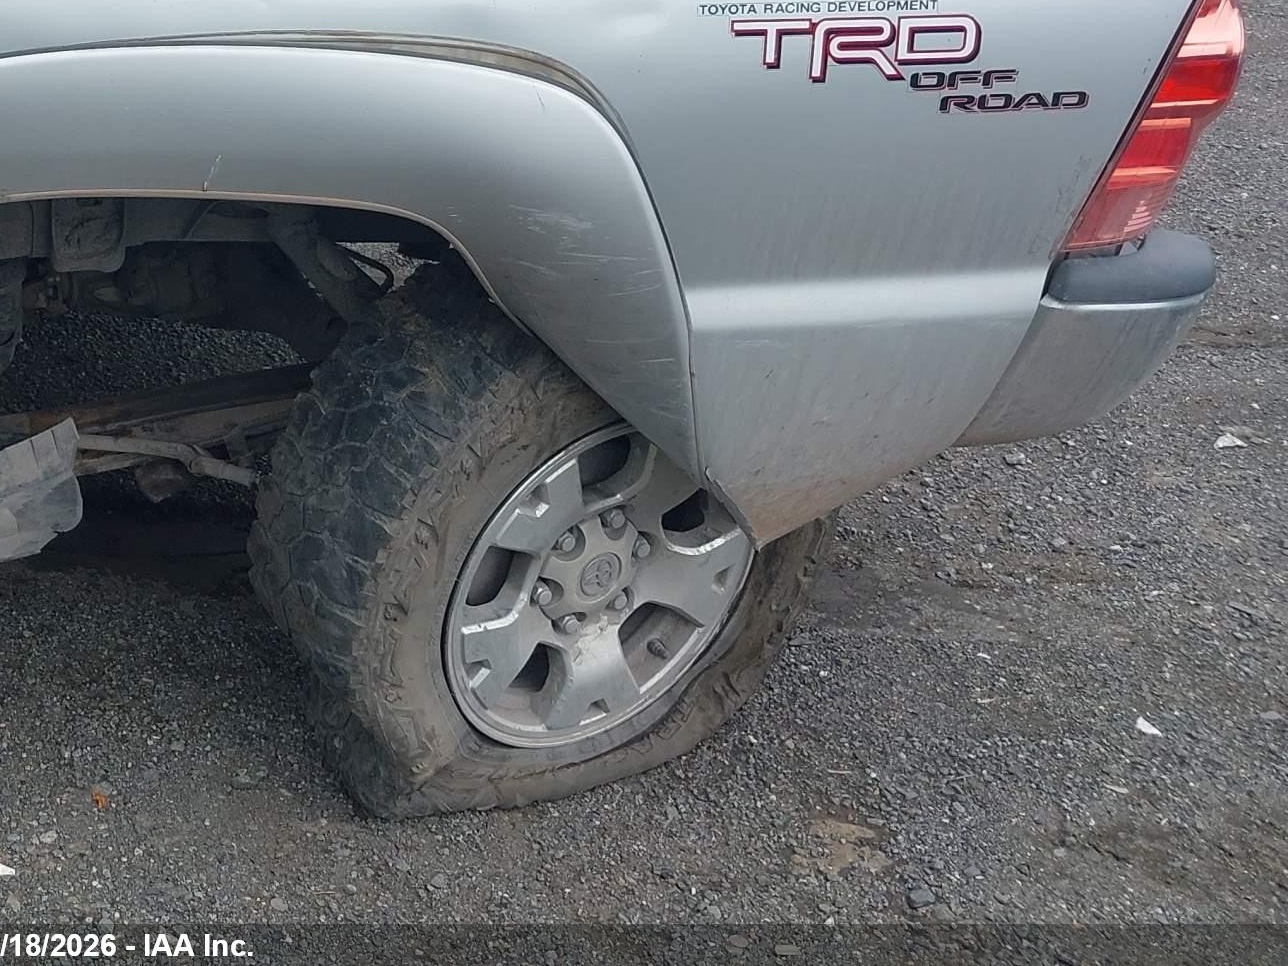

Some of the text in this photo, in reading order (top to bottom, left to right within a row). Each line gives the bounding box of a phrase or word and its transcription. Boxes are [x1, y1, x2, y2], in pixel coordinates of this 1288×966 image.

[699, 0, 938, 15] TOYOTA RACING DEVELOPMENT
[730, 15, 982, 82] TRD
[909, 68, 1019, 91] OFF
[939, 90, 1090, 114] ROAD
